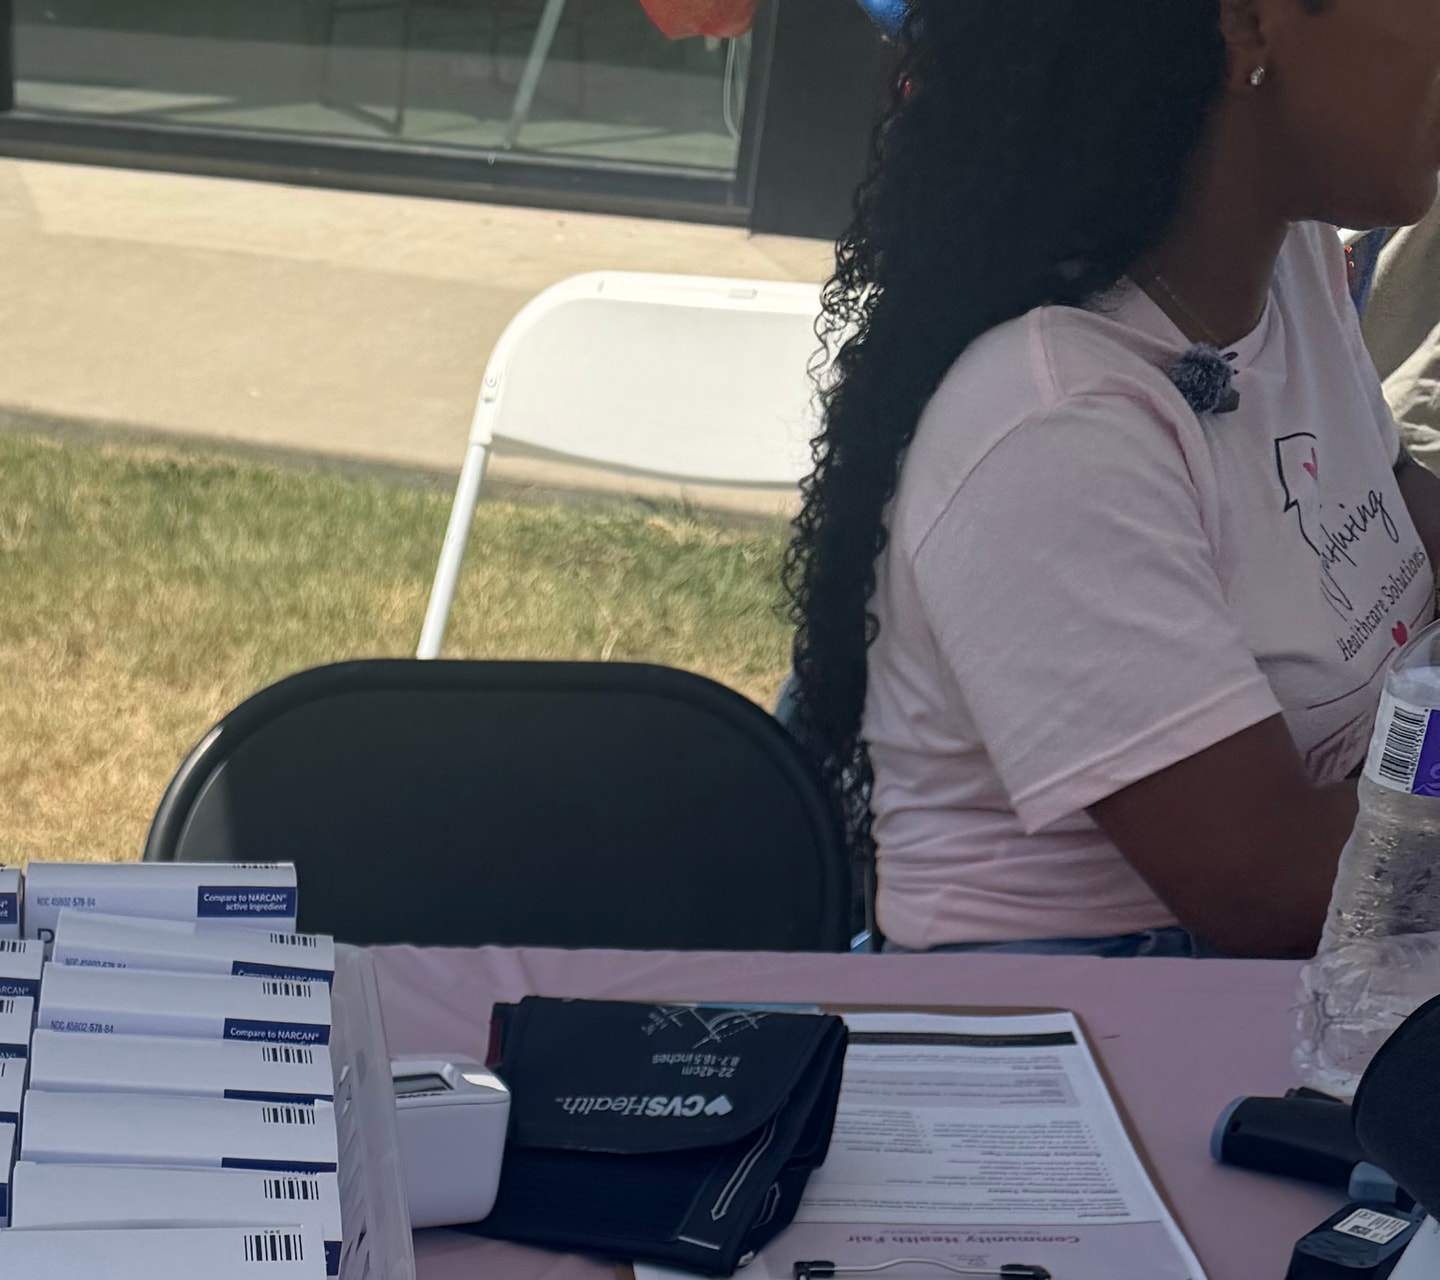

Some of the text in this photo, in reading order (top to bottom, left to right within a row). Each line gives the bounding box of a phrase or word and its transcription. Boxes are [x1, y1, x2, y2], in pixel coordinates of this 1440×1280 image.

[1338, 547, 1427, 662] Healthcare Solutions
[652, 1053, 692, 1065] inches
[681, 1067, 735, 1078] 22-42cm
[845, 1234, 885, 1245] Fair
[891, 1234, 960, 1246] Health
[964, 1233, 1081, 1245] Community
